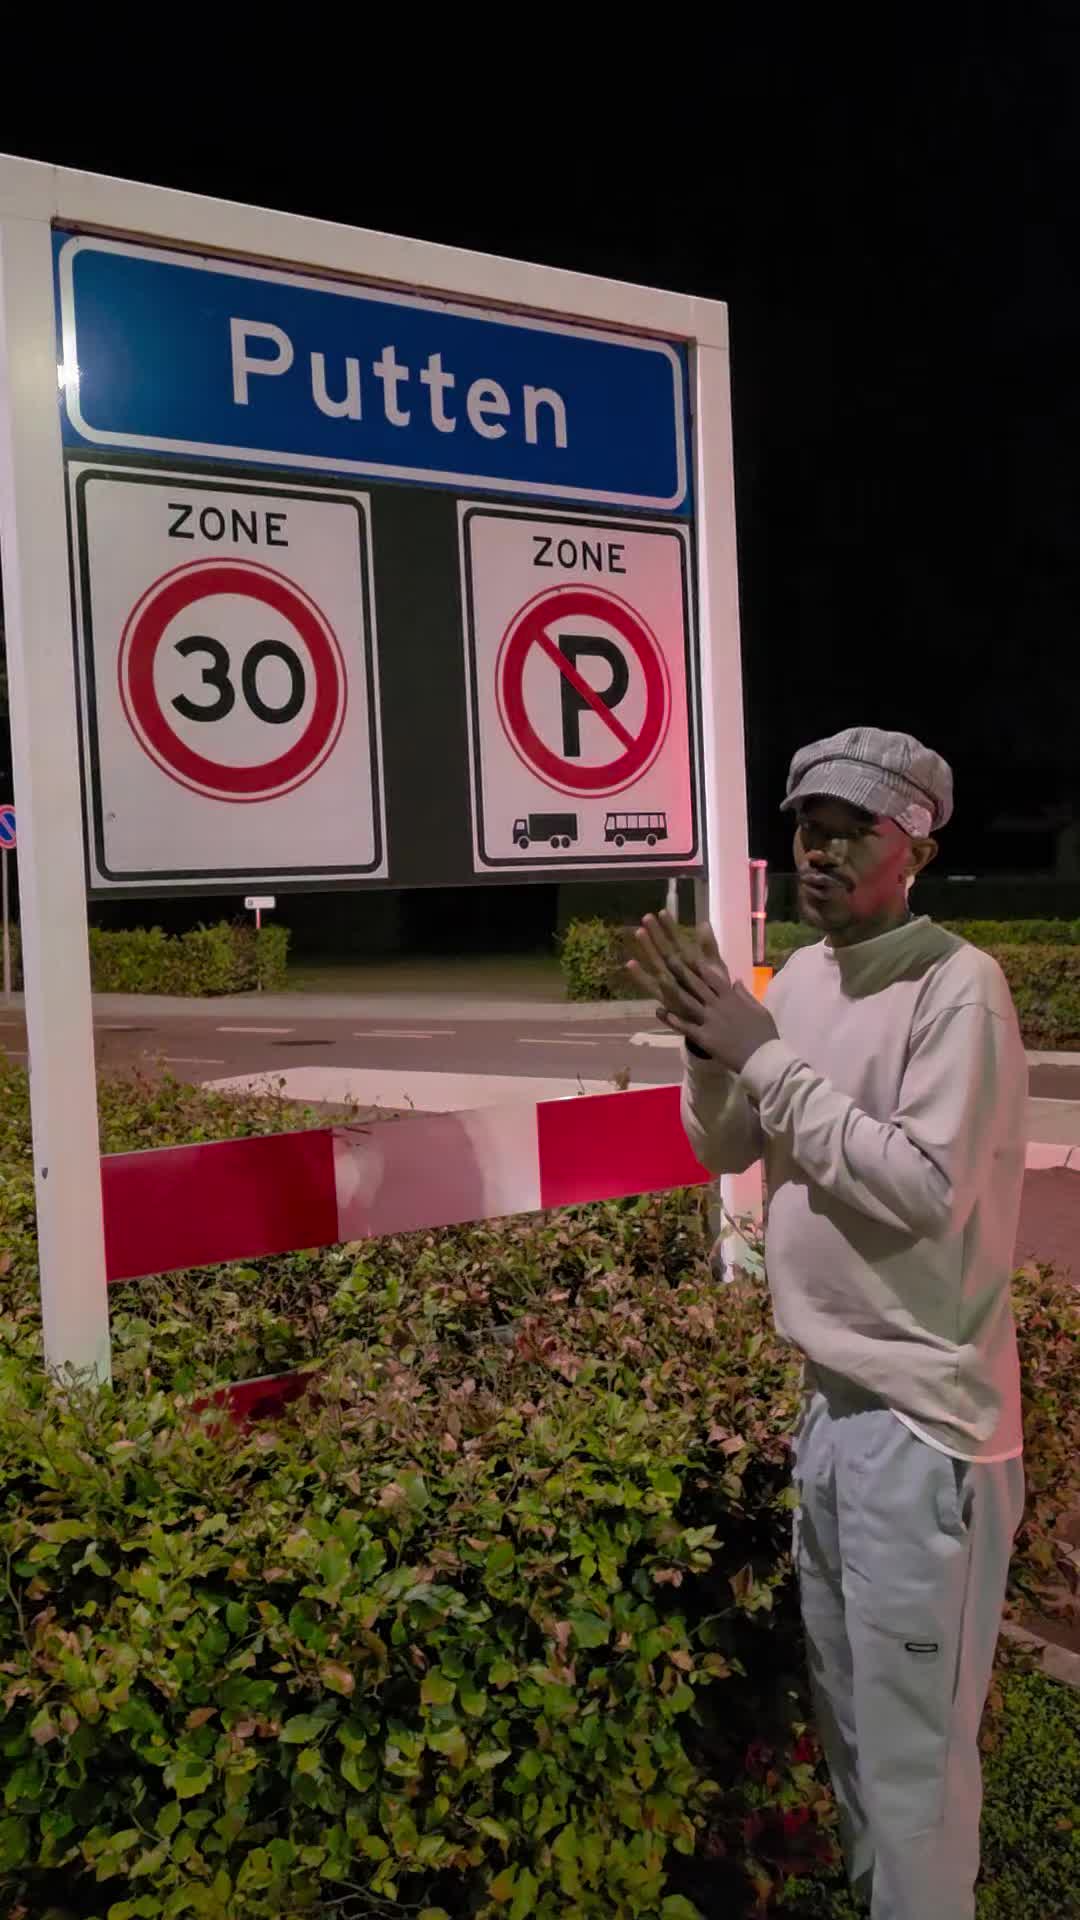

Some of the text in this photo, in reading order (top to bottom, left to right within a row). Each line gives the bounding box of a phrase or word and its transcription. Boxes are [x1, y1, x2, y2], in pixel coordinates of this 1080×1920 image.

[230, 318, 567, 448] Putten
[167, 503, 289, 547] ZONE
[532, 536, 627, 573] ZONE
[171, 634, 306, 725] 30
[558, 634, 629, 757] P
